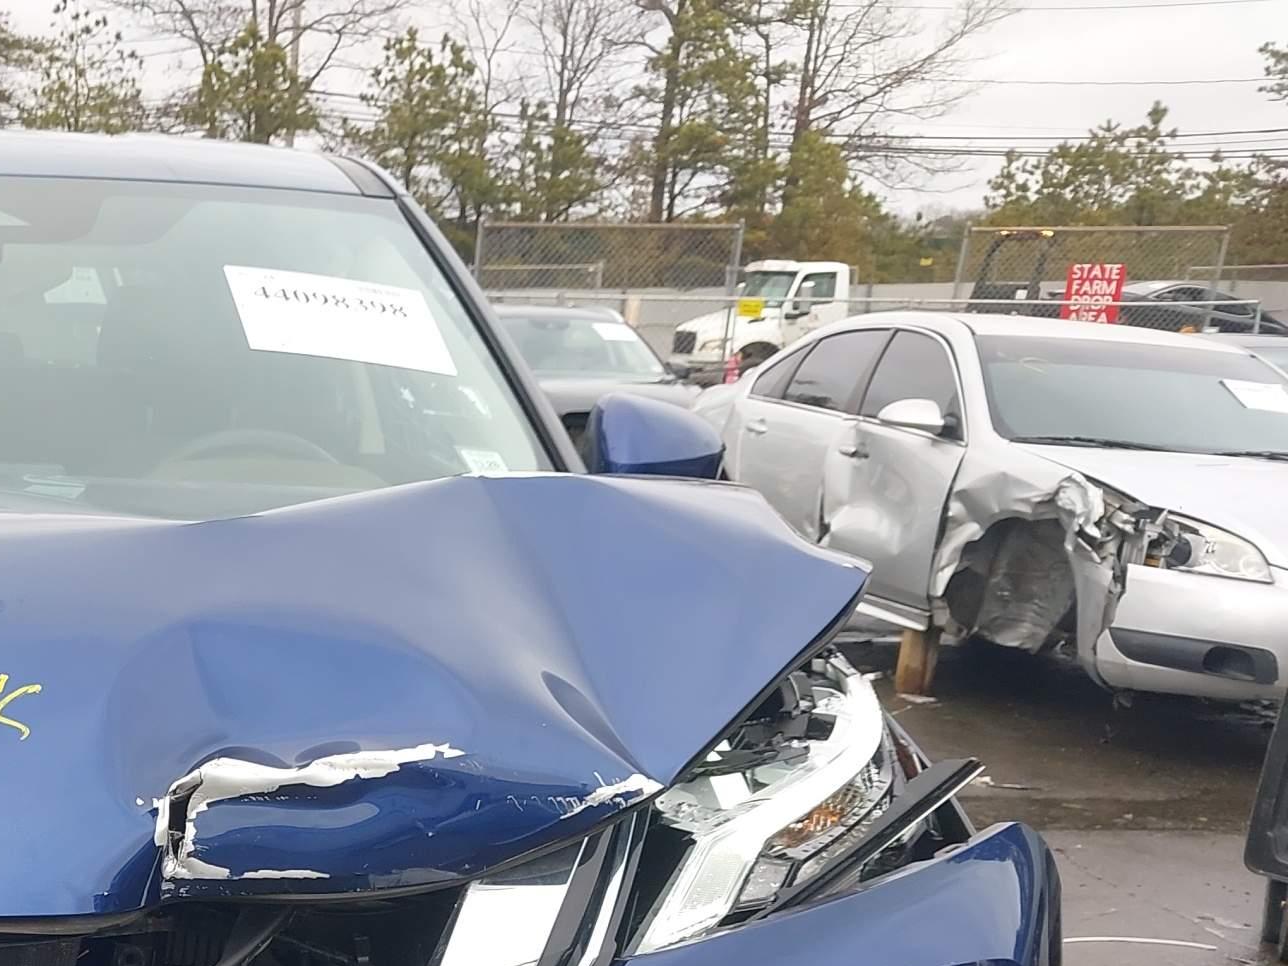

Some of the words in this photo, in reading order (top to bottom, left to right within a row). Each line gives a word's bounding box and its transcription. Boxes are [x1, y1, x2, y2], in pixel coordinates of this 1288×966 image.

[1071, 263, 1123, 279] STATE
[1071, 279, 1118, 295] FARM
[254, 285, 408, 318] 44098398
